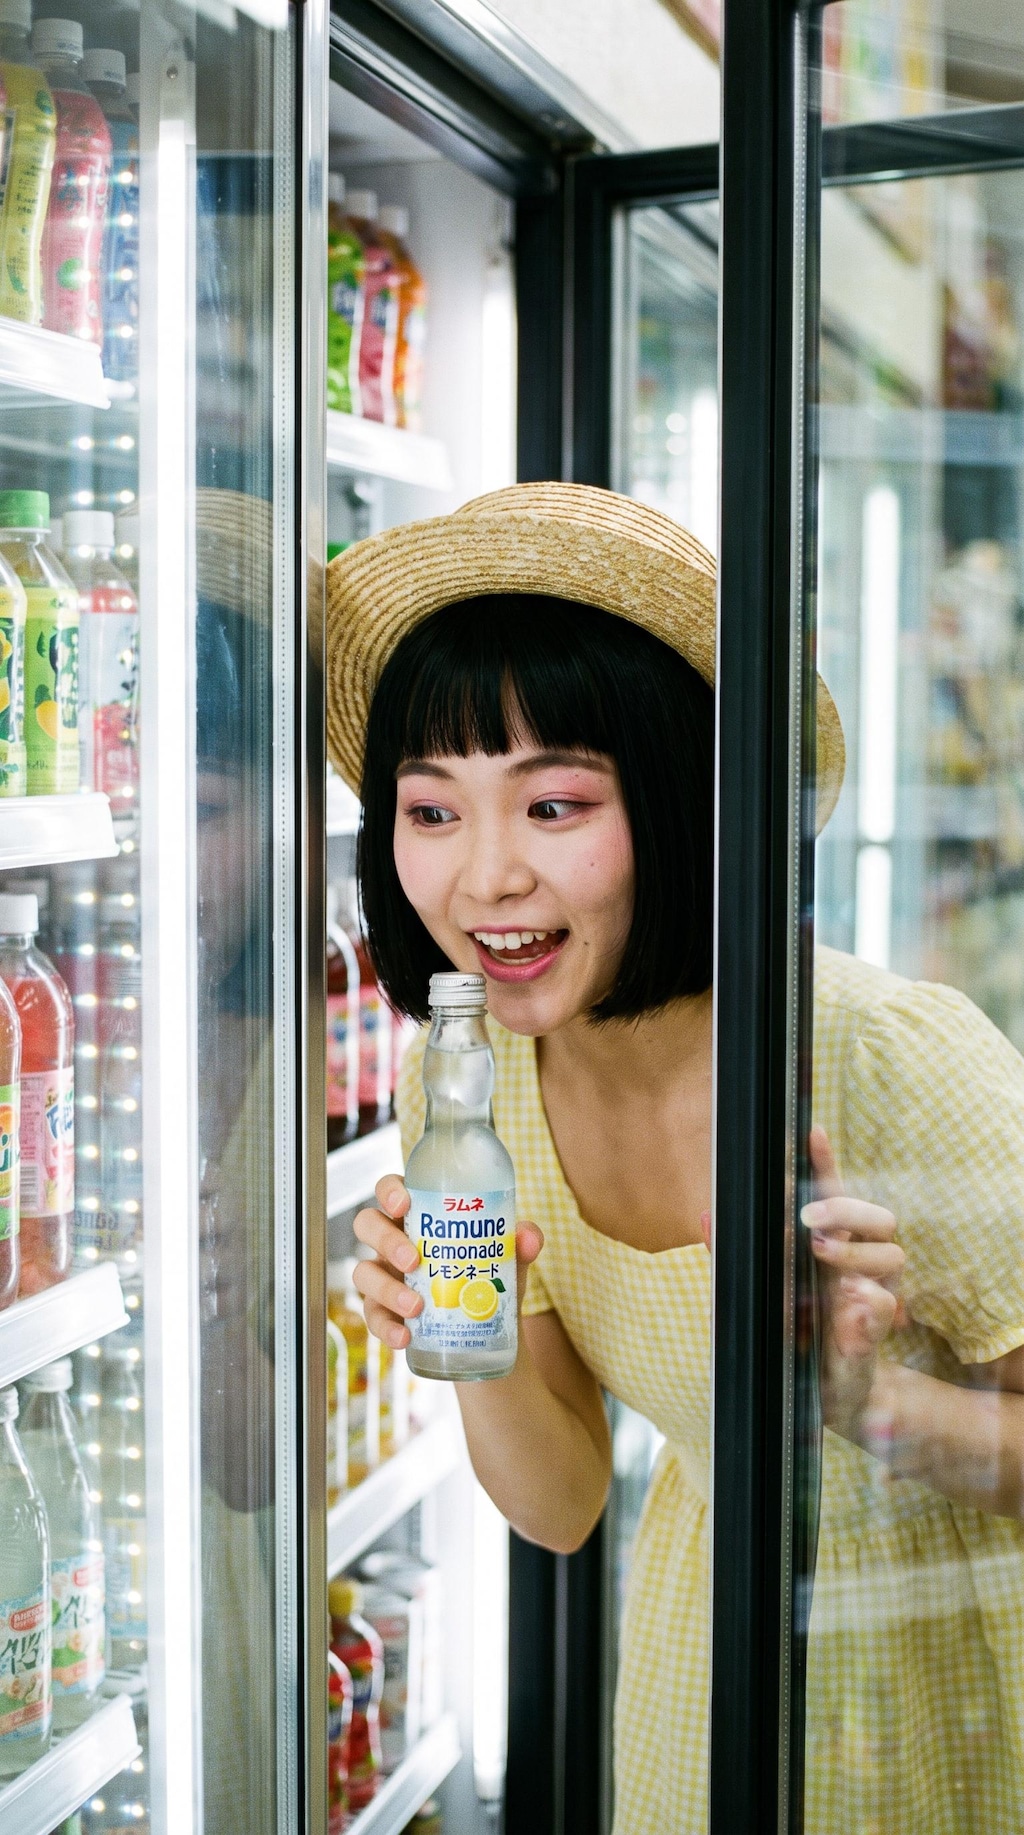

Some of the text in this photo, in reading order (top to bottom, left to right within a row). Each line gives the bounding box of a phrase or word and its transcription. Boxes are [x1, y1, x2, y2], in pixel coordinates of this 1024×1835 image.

[443, 1197, 485, 1212] ラムネ
[420, 1213, 505, 1239] Ramune
[422, 1240, 504, 1260] Lemonade
[429, 1263, 499, 1280] レモンネード
